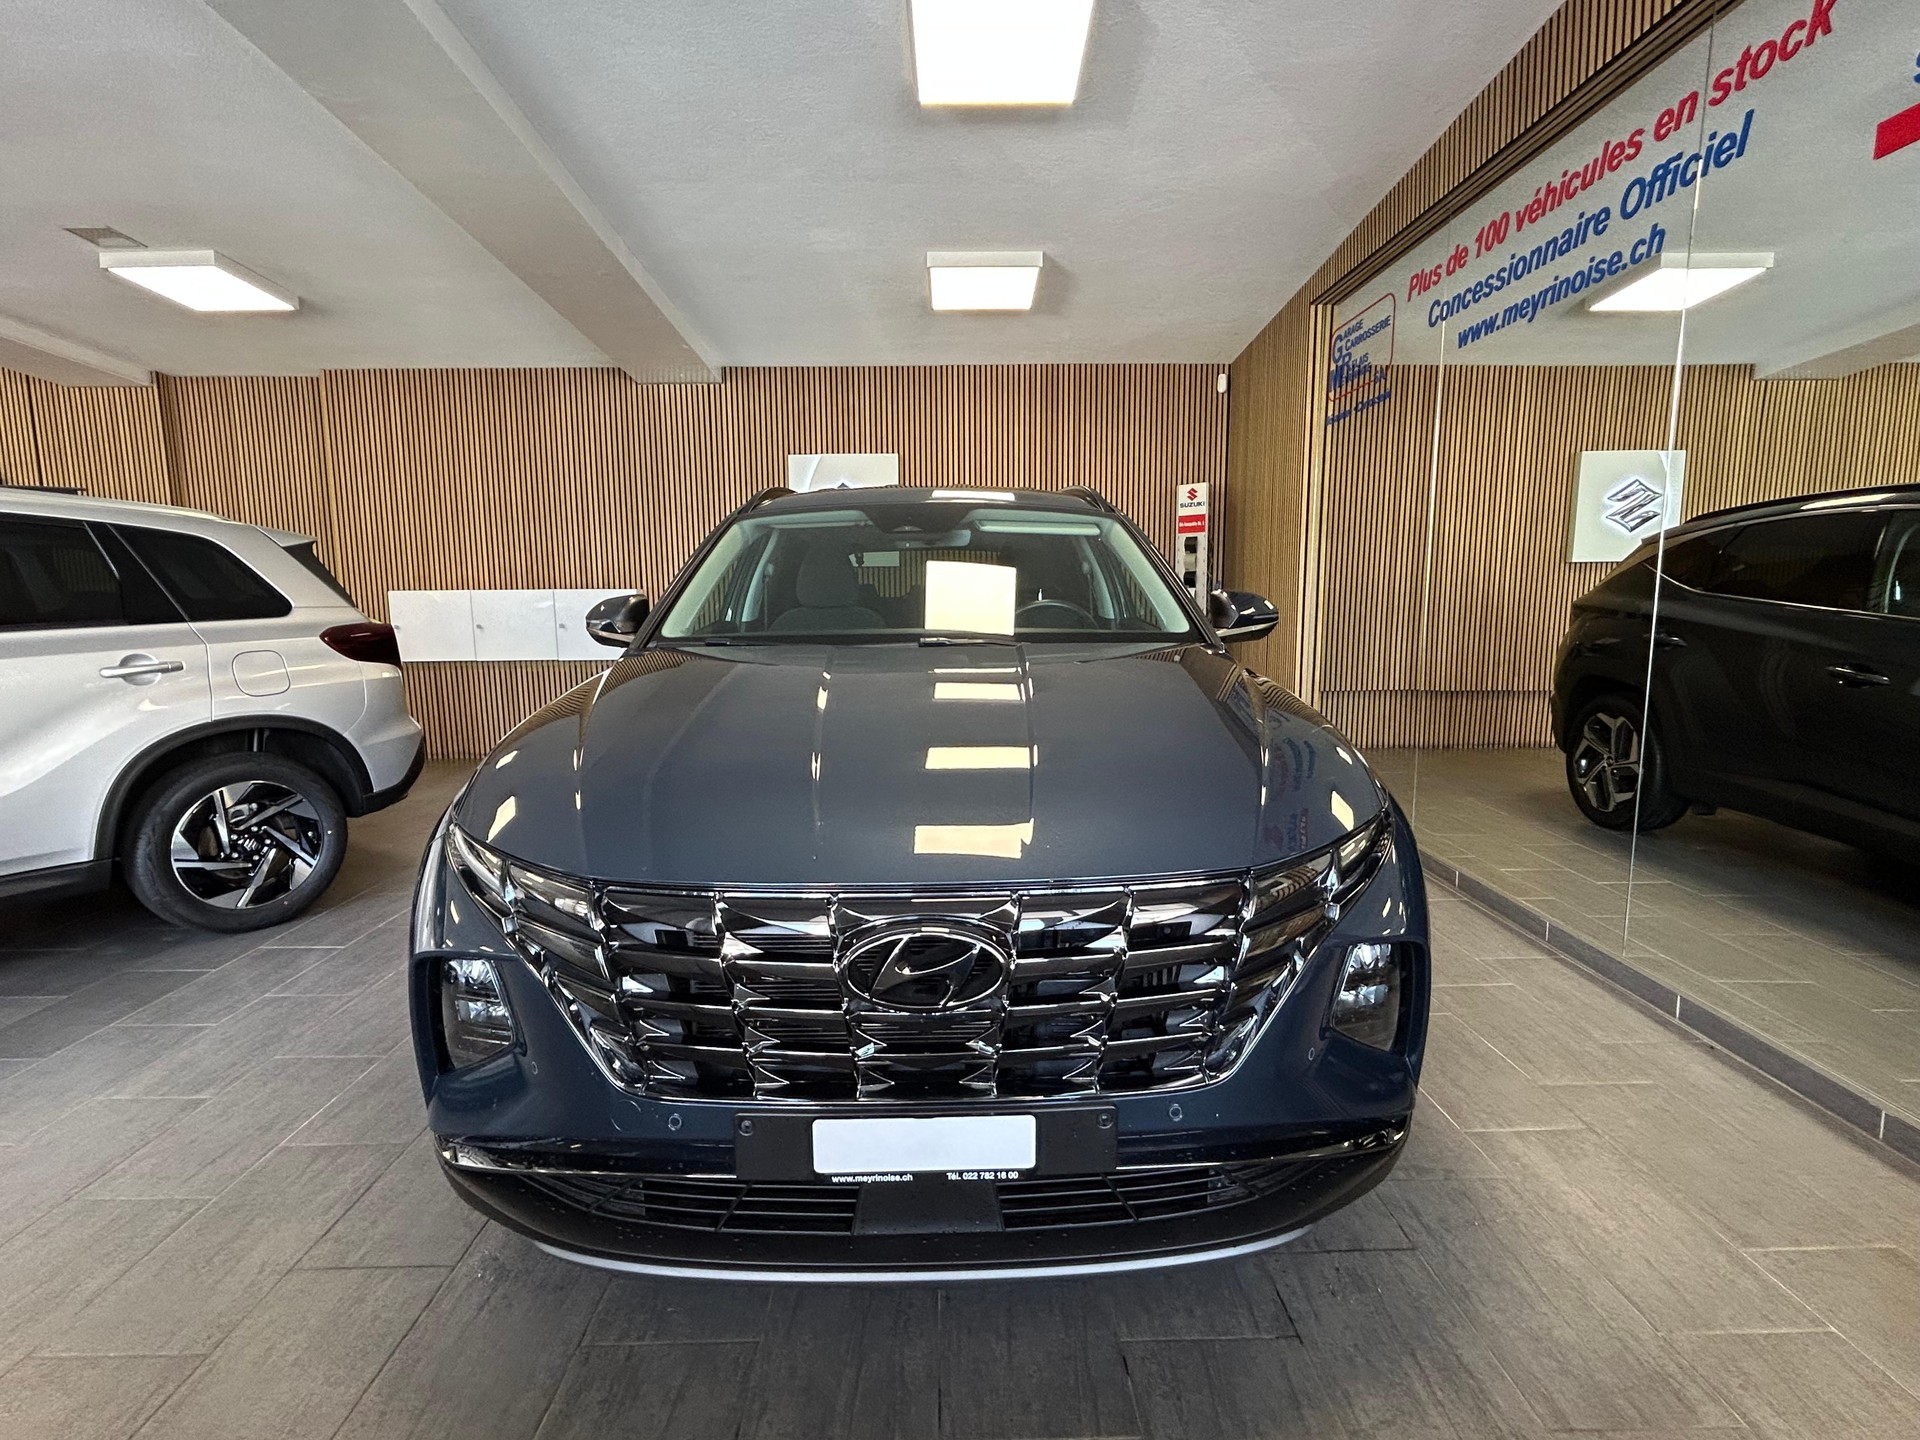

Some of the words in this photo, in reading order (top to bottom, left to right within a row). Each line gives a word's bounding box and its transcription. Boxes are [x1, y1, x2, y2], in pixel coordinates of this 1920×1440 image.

[1408, 263, 1442, 302] Plus
[1446, 244, 1469, 276] de
[1475, 211, 1510, 260] 100
[1515, 128, 1645, 234] véhicules
[1653, 90, 1699, 143] en
[1708, 0, 1838, 107] stock
[1428, 206, 1611, 328] Concessionnaire
[1619, 108, 1756, 221] Officiel
[1457, 222, 1667, 349] www.meyrinoise.ch
[831, 1173, 914, 1183] www.meyrinoise.ch
[962, 1171, 979, 1181] 022
[979, 1171, 995, 1180] 782
[1007, 1170, 1019, 1180] 00
